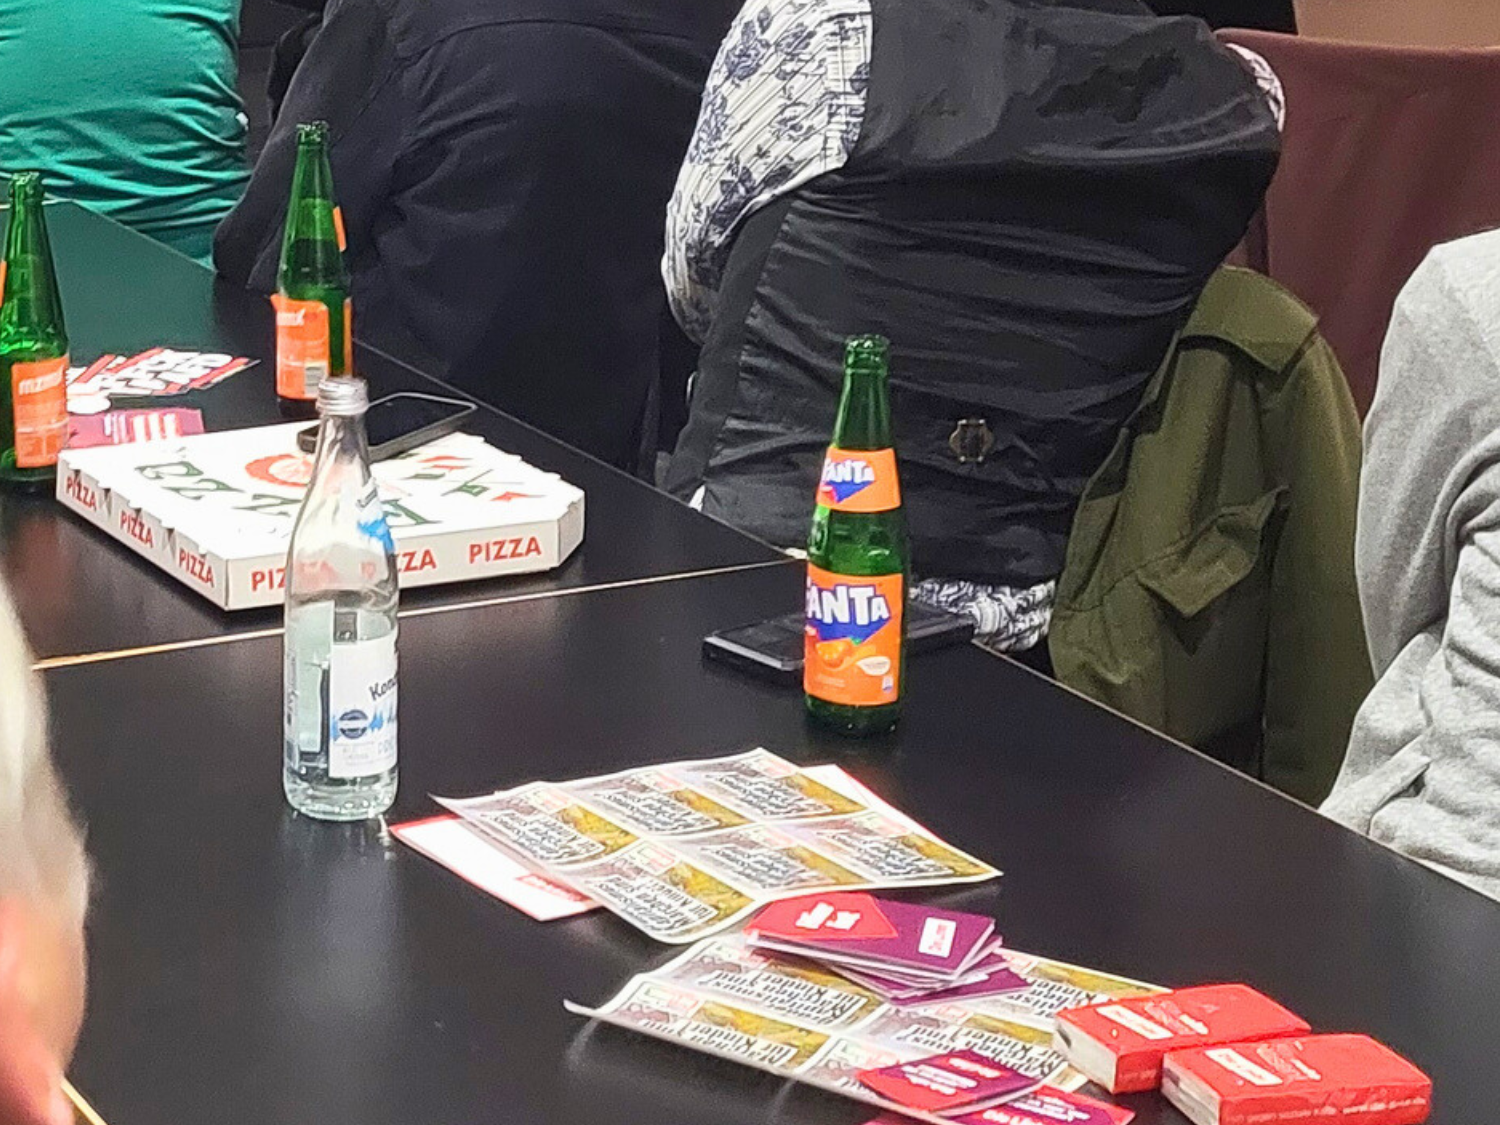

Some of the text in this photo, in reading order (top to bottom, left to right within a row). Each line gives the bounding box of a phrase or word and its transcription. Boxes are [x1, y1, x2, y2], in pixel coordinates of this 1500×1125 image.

[66, 475, 97, 511] PIZZA
[120, 510, 154, 548] PIZZA
[179, 548, 215, 588] PIZZA
[469, 536, 542, 565] PIZZA
[805, 576, 891, 625] ANTA
